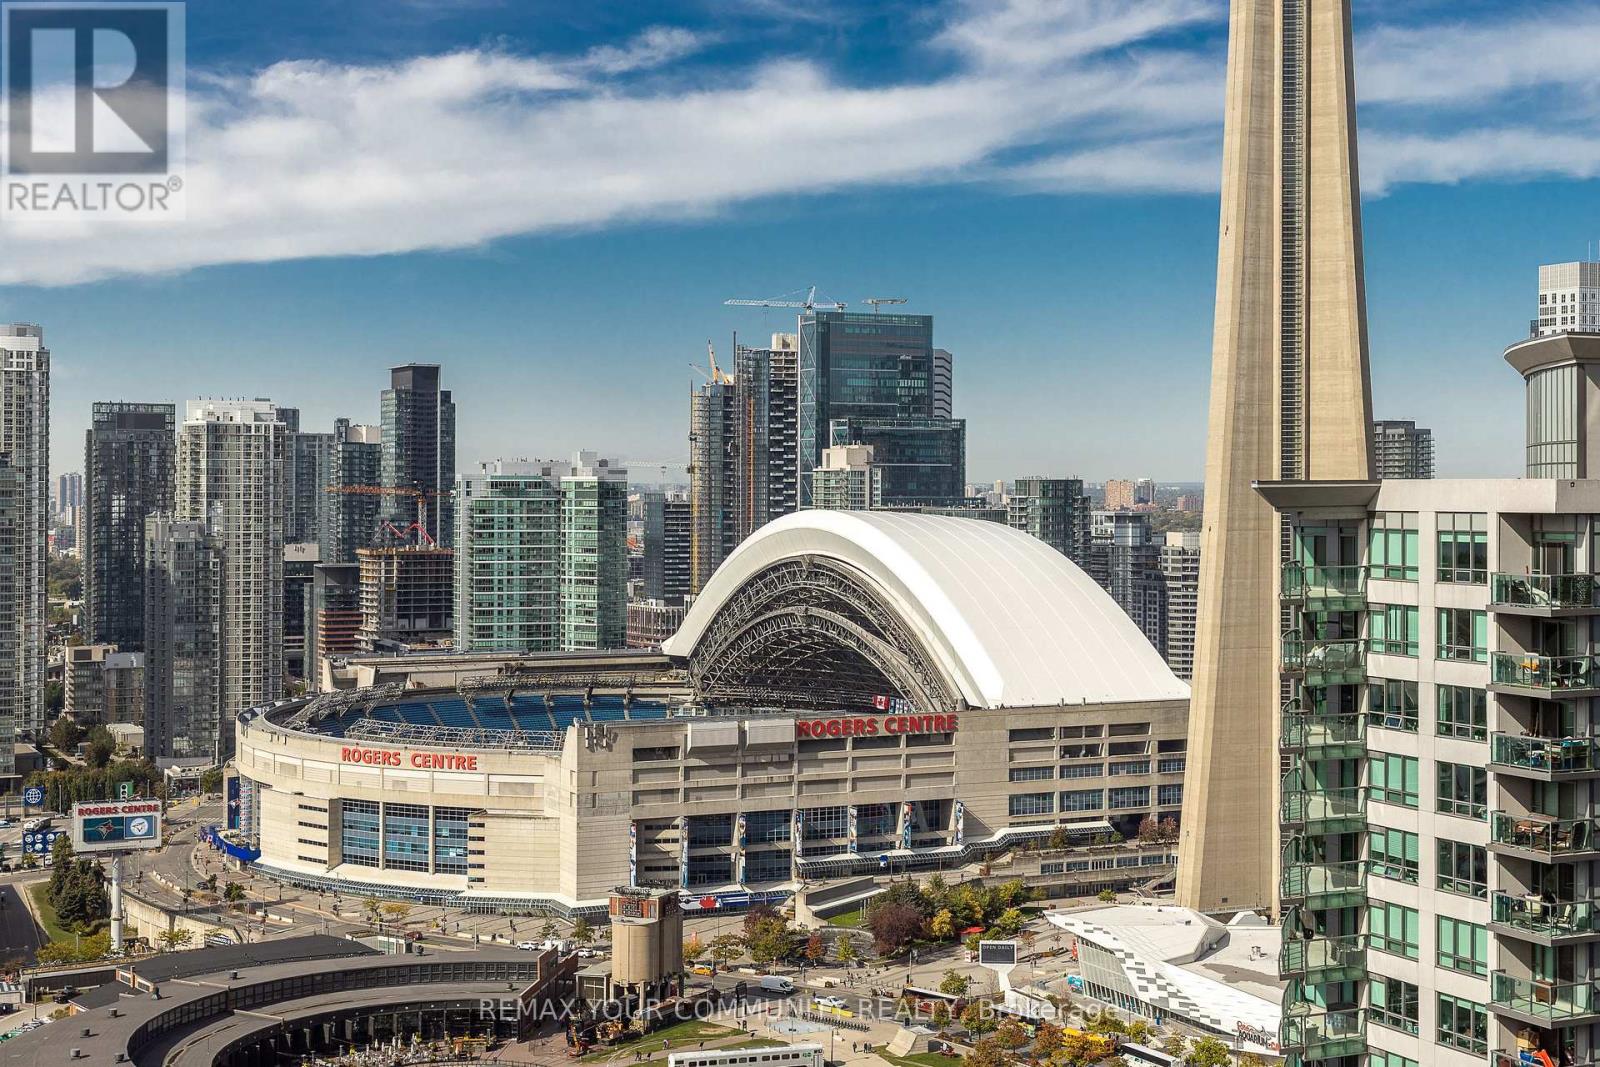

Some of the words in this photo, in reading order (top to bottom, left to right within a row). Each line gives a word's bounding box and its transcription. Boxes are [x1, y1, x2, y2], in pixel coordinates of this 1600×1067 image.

[796, 718, 879, 739] ROGERS
[884, 714, 959, 735] CENTRE
[341, 747, 402, 767] ROGERS
[410, 752, 478, 771] CENTRE
[78, 806, 120, 817] ROGERS
[121, 804, 159, 814] CENTRE
